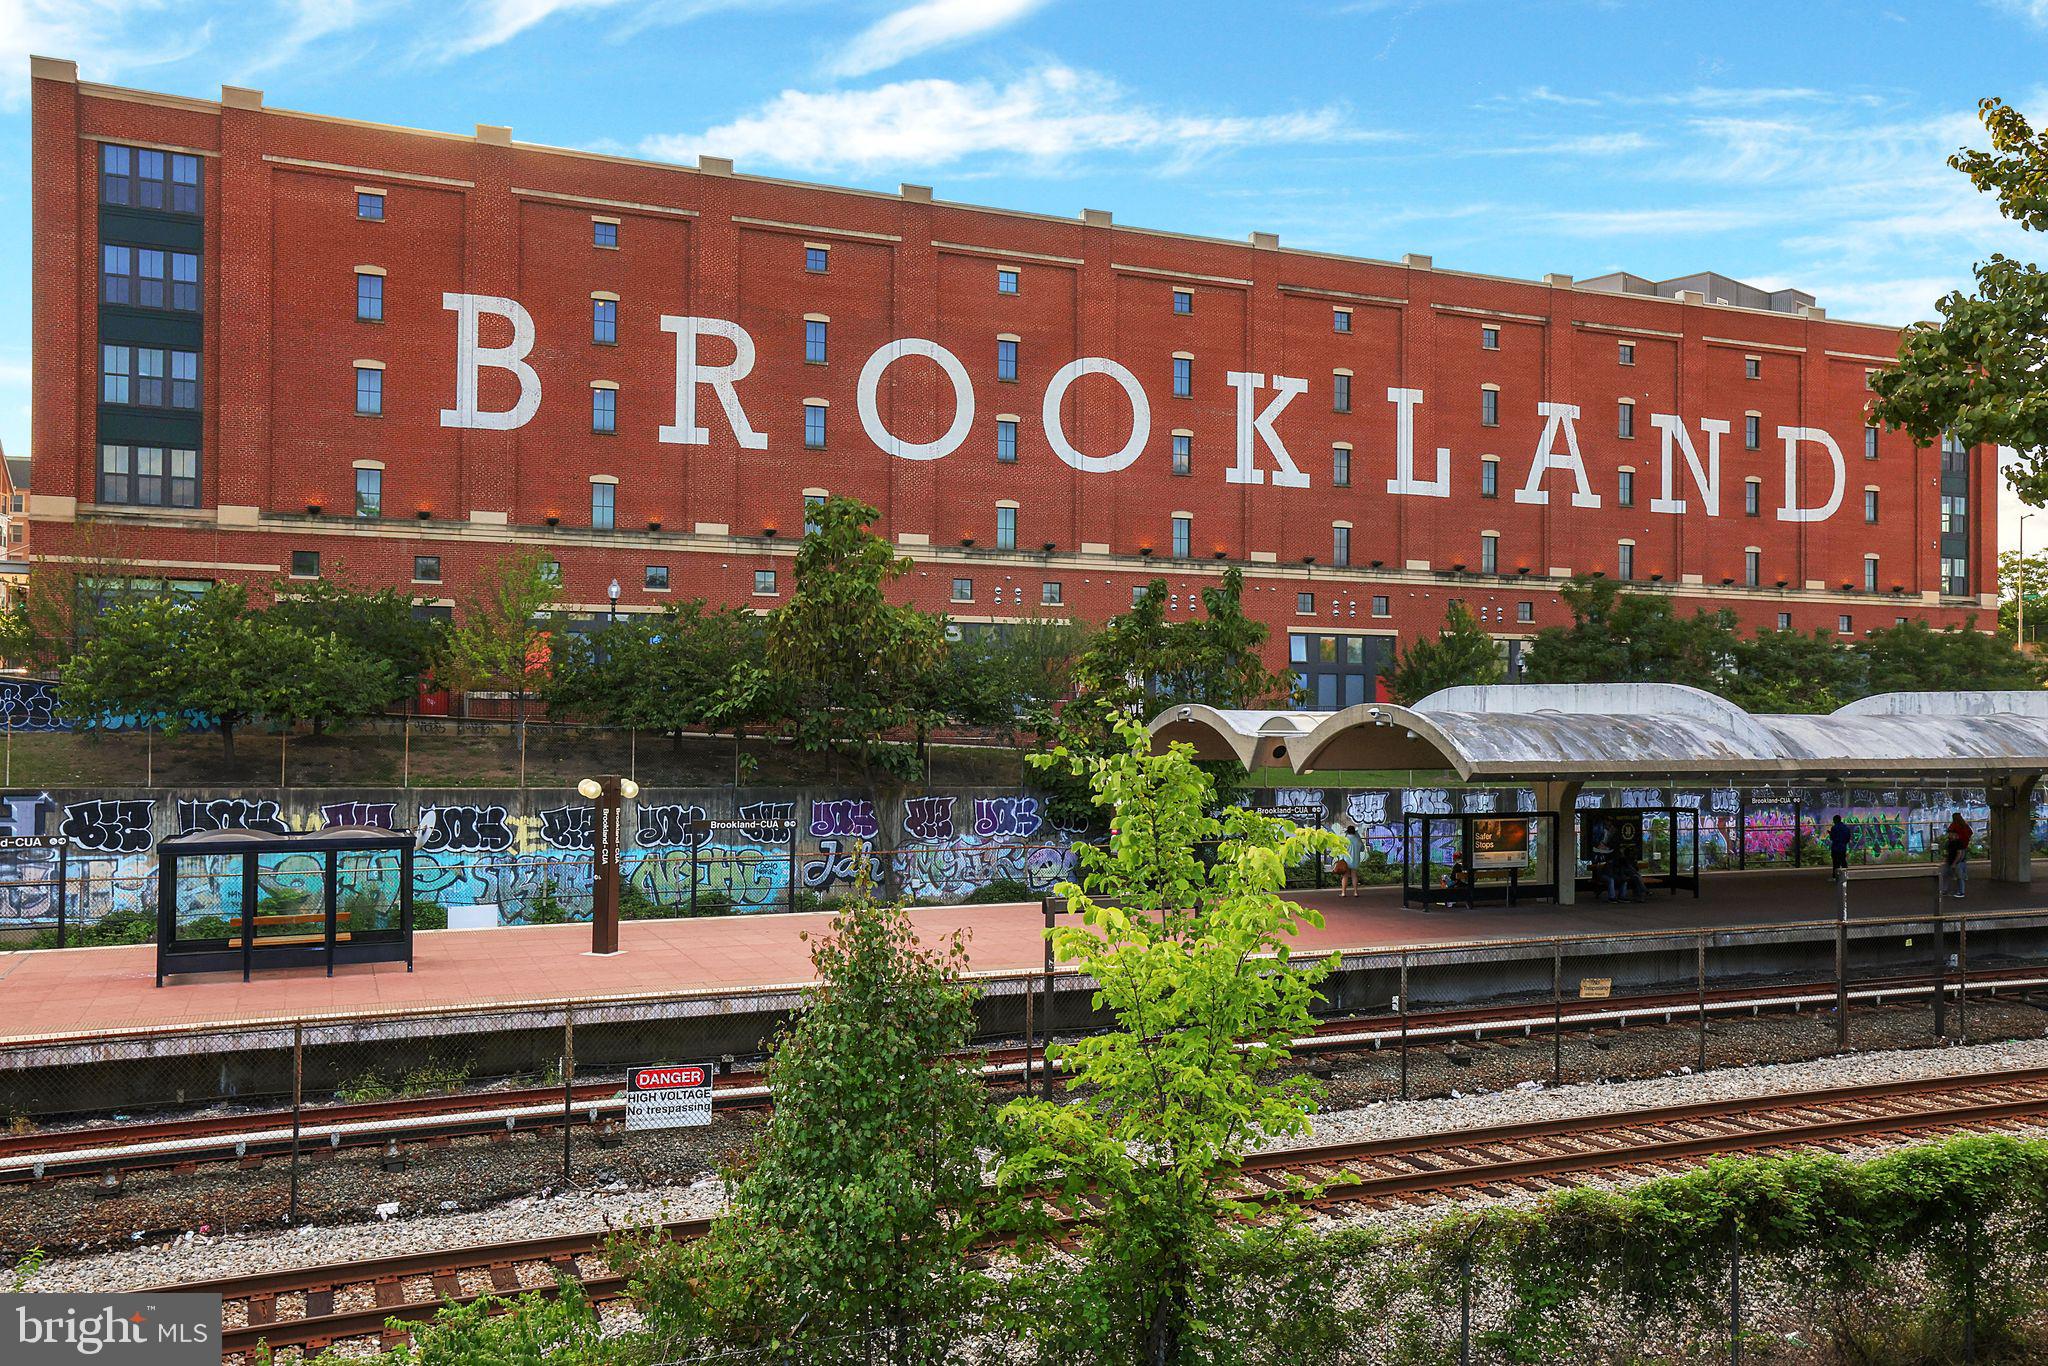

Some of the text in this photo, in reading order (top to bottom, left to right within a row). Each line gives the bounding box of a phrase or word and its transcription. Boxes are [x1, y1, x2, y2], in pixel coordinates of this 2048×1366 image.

[440, 292, 1847, 522] BROOKLAND
[710, 820, 779, 829] Brookland-CUA
[1475, 832, 1493, 840] Safer
[1475, 841, 1494, 850] Stops
[639, 1071, 701, 1085] DANGER
[628, 1089, 711, 1103] HIGH VOLTAGE
[627, 1103, 711, 1116] No trespassing
